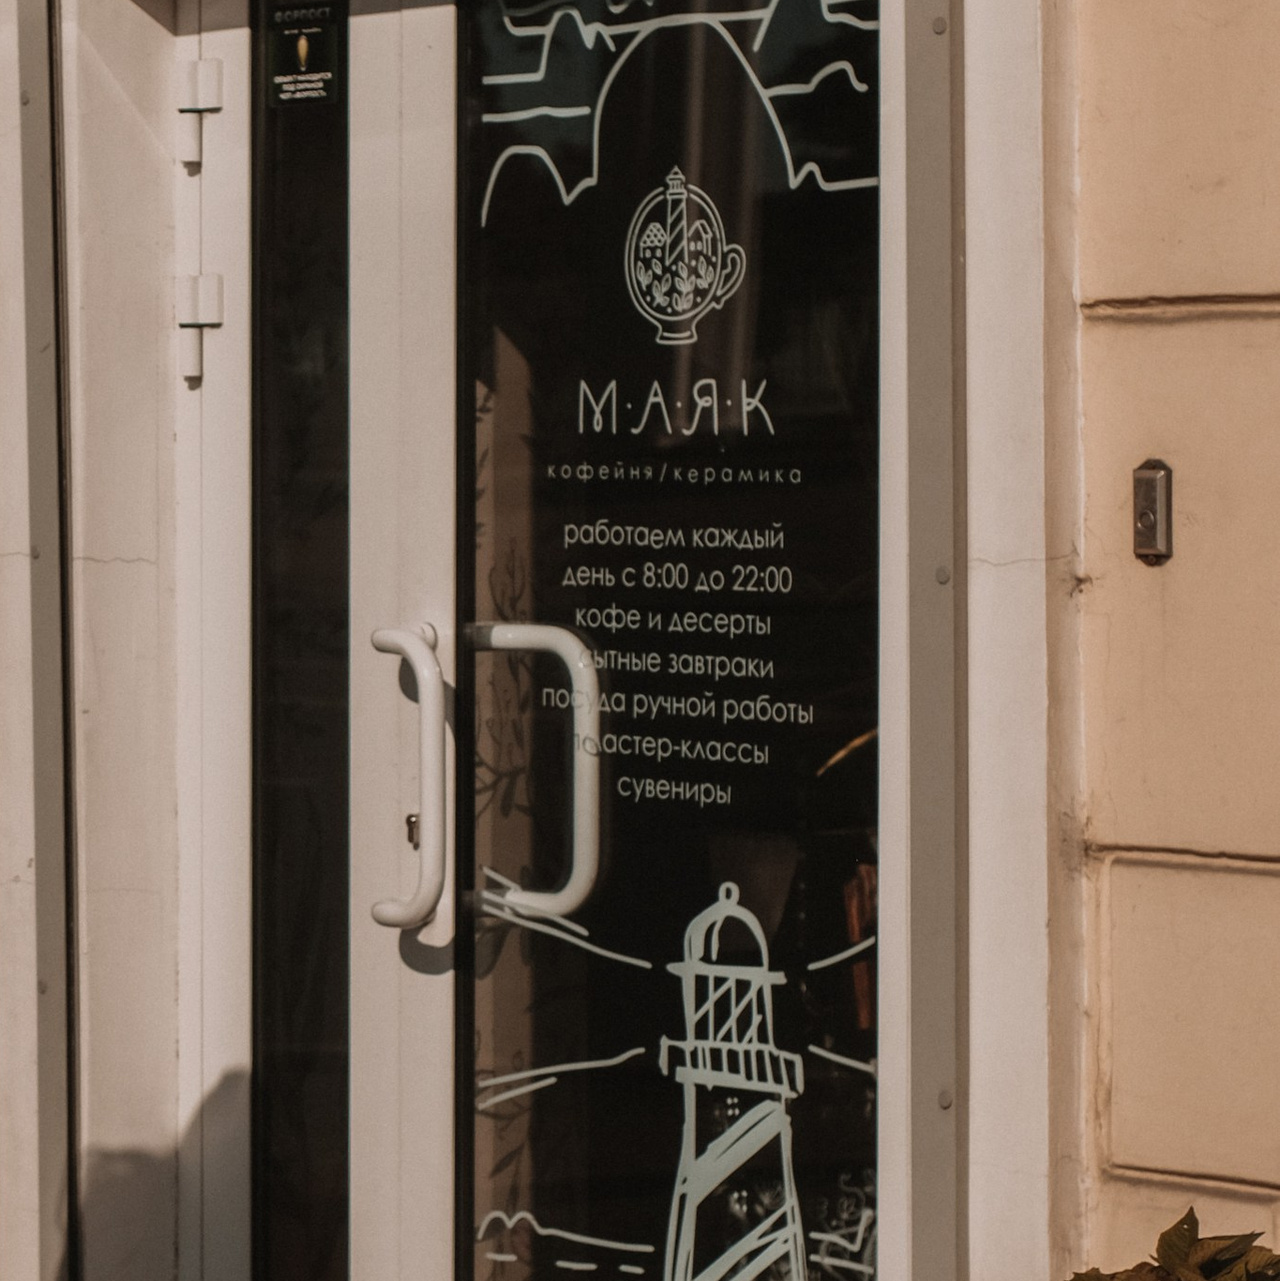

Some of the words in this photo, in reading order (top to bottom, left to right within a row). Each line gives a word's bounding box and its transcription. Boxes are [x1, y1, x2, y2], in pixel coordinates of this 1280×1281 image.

[546, 460, 803, 485] кофейня/керамика
[563, 519, 686, 549] работаем
[692, 522, 785, 551] каждый
[562, 564, 615, 588] день
[622, 566, 636, 587] с
[643, 562, 689, 590] 8:00
[694, 569, 726, 593] до
[732, 564, 793, 594] 22:00
[576, 604, 641, 633] кофе
[648, 613, 662, 630] и
[668, 610, 771, 639] десерты
[668, 652, 774, 681] завтраки
[633, 691, 715, 719] ручной
[723, 695, 814, 725] работы
[578, 732, 769, 765] астер-классы
[617, 775, 731, 805] сувениры
